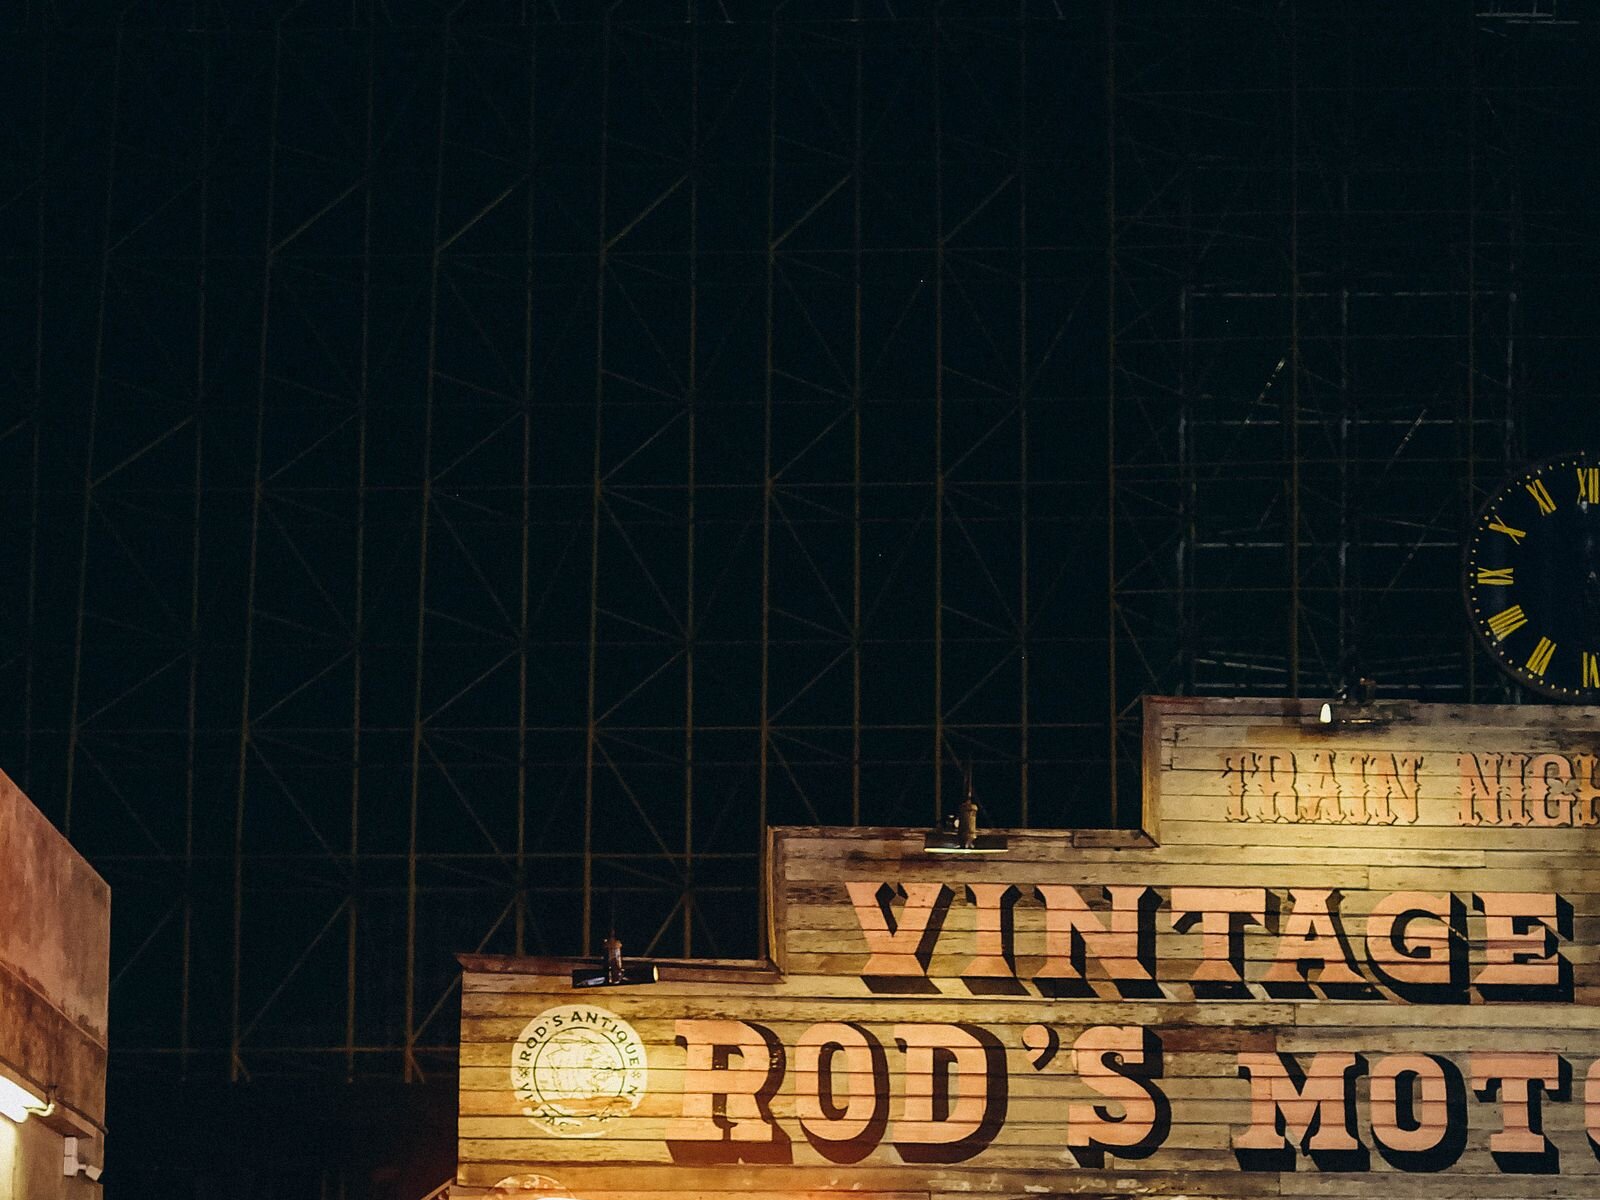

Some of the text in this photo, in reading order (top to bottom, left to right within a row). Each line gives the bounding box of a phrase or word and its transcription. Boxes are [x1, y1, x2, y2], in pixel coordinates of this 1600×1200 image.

[1221, 748, 1425, 826] TRAIN
[845, 881, 1575, 1005] VINTAGE
[519, 1011, 640, 1067] ROD'S ANTIQUE
[664, 1019, 1600, 1176] ROD'S MOT
